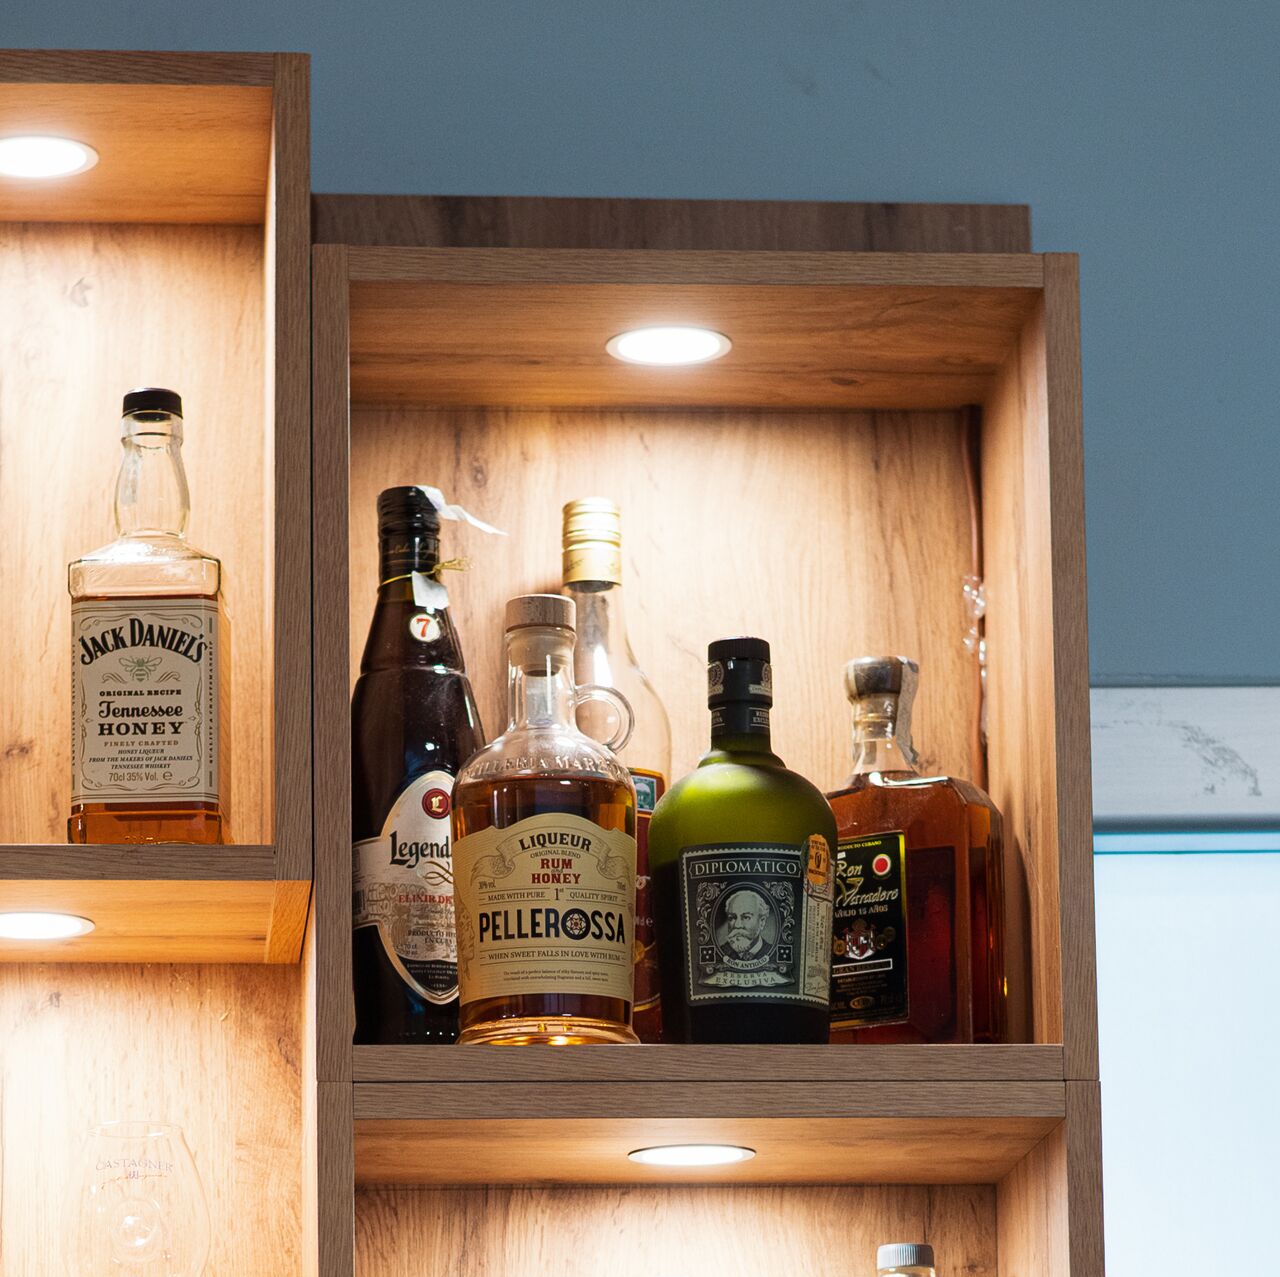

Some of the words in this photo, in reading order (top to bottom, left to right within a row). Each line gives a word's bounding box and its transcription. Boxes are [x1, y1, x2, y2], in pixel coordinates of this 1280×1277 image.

[416, 618, 430, 638] 7
[78, 626, 128, 666] JACK
[129, 618, 208, 663] DANIEL'S
[147, 689, 182, 697] RECIPE
[98, 701, 183, 719] Tennessee
[98, 722, 185, 736] HONEY
[109, 772, 125, 782] 70cl
[126, 772, 144, 782] 35%
[144, 772, 159, 782] Vol.
[518, 832, 592, 852] LIQUEUR
[389, 830, 453, 869] Legend
[530, 850, 561, 859] ORIGINAL
[561, 850, 581, 859] BLEND
[541, 858, 573, 870] RUM
[695, 859, 797, 875] DIPLOMÁTICO
[836, 860, 863, 877] Ron
[531, 873, 581, 885] HONEY
[399, 895, 436, 903] ELIXIR
[488, 893, 505, 901] MADE
[506, 892, 526, 900] WITH
[526, 891, 546, 899] PURE
[570, 891, 600, 901] QUALITY
[479, 907, 626, 945] PELLEROSSA
[488, 951, 509, 960] WHEN
[510, 951, 535, 959] SWEET
[537, 950, 560, 958] FALLS
[571, 950, 590, 958] LOVE
[590, 952, 608, 960] WITH
[608, 953, 622, 961] RUM
[727, 957, 740, 968] RON
[715, 976, 776, 986] EXCLUSIVA
[723, 971, 768, 979] RESERVA
